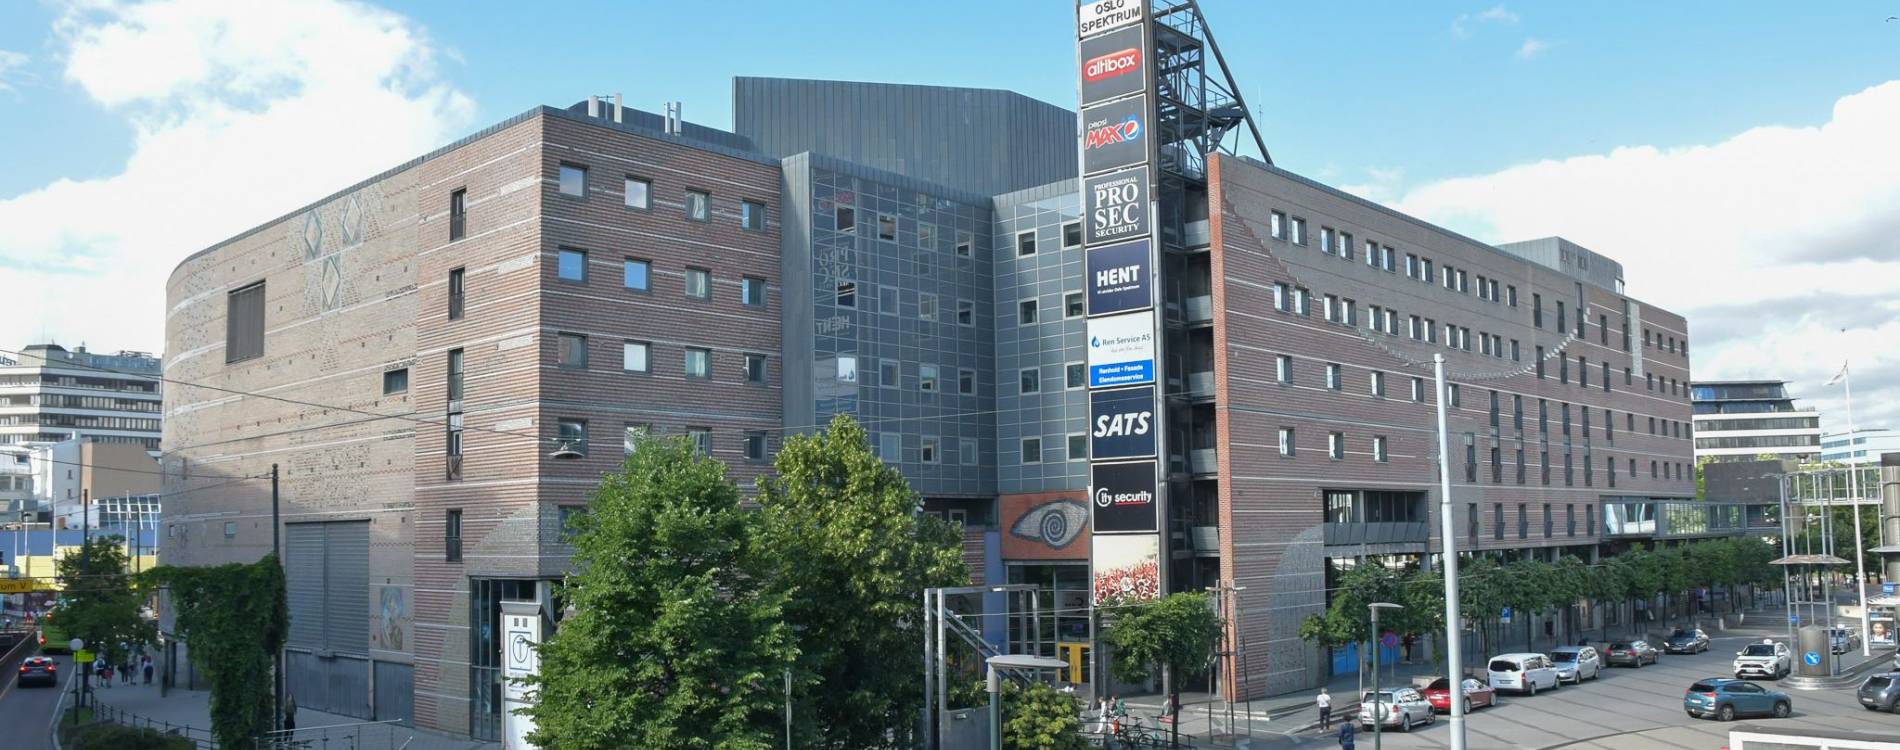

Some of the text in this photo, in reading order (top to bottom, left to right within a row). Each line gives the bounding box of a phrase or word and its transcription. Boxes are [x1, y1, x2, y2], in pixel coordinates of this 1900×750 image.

[1095, 0, 1124, 14] OSLO
[1081, 6, 1140, 33] SPEKTRUM
[1087, 54, 1136, 77] altibox
[1084, 122, 1125, 150] MAX
[1095, 183, 1139, 208] PRO
[1095, 202, 1140, 230] SEC
[1095, 223, 1140, 238] SECURITY
[1096, 264, 1140, 287] HENT
[1102, 338, 1115, 346] Ren
[1116, 336, 1140, 345] Service
[1093, 411, 1152, 438] SATS
[1096, 487, 1152, 508] City security
